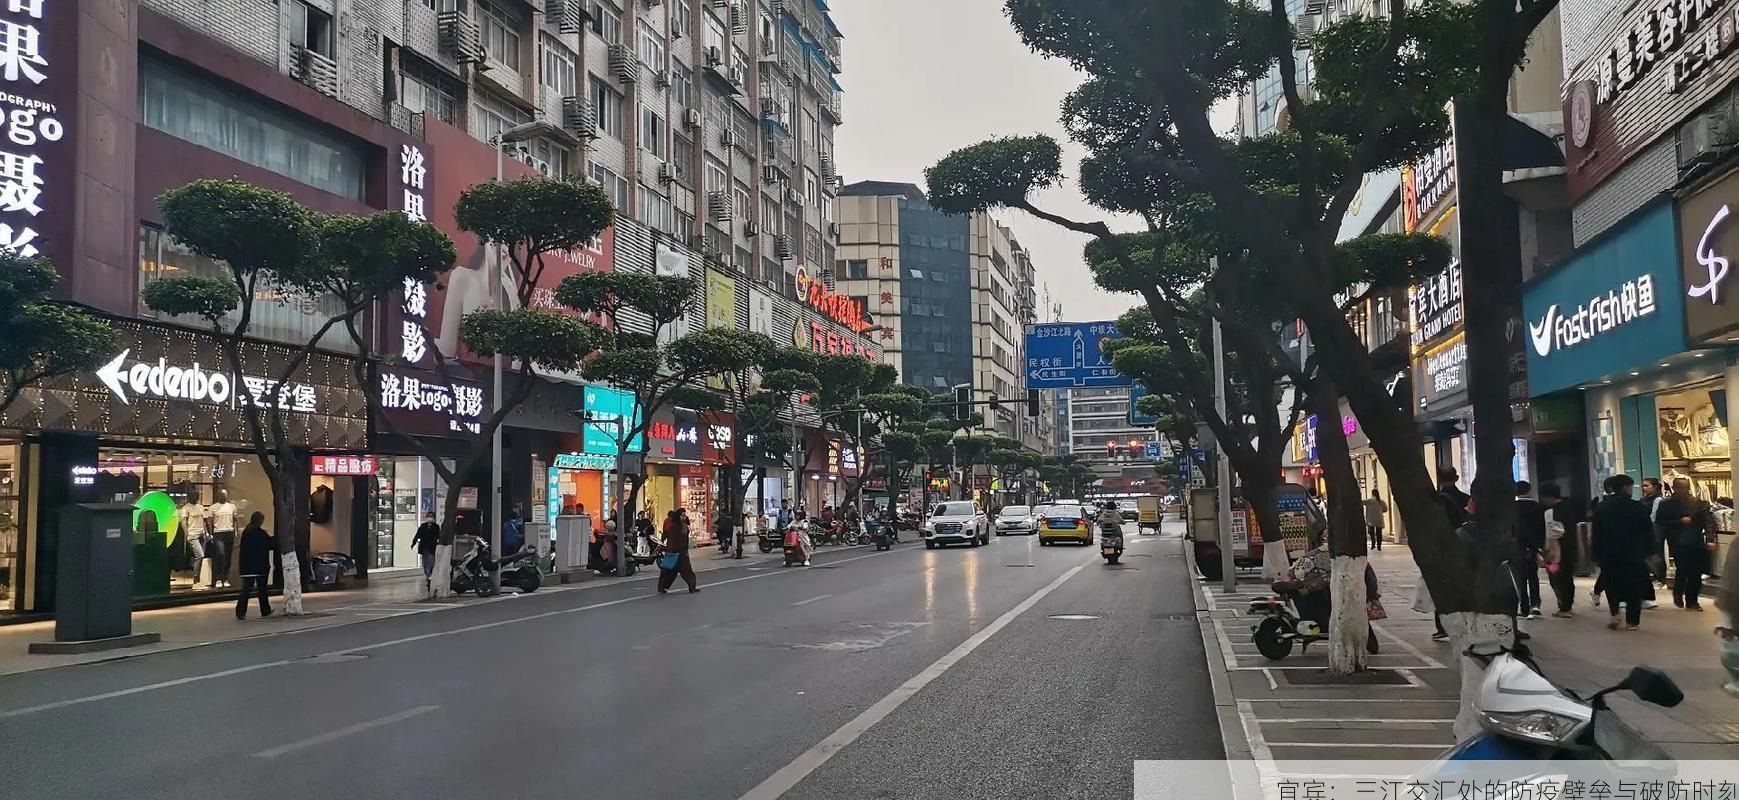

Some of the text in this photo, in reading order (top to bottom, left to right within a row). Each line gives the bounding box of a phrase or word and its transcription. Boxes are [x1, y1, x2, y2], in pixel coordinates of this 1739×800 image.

[1620, 273, 1655, 322] 快鱼
[1089, 325, 1120, 336] 中坝大
[1424, 316, 1442, 340] GRAND
[1441, 302, 1462, 329] HOTEL
[1036, 327, 1072, 338] 金沙江北路
[1029, 357, 1062, 368] 民权街
[381, 373, 421, 411] 洛果
[421, 391, 449, 412] Logo
